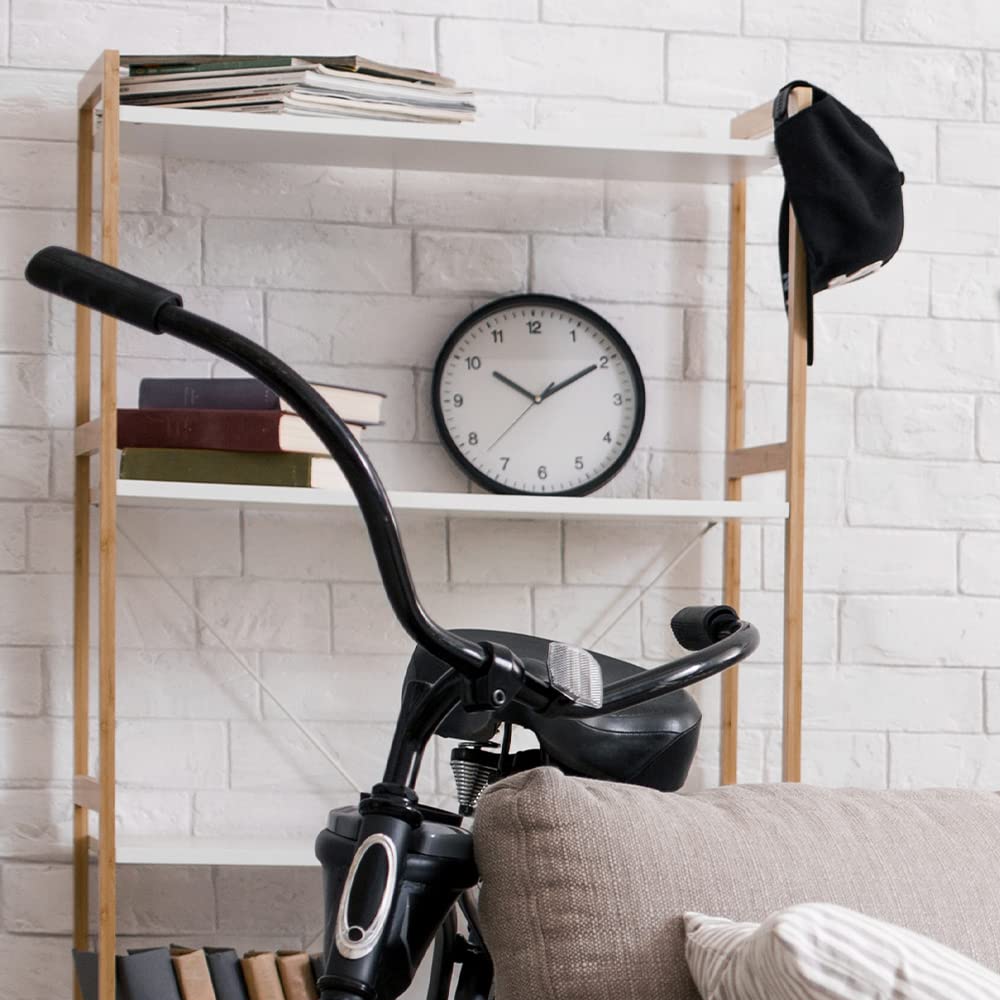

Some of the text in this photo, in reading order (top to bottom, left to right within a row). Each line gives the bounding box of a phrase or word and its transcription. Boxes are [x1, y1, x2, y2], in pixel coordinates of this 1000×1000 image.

[526, 320, 542, 334] 12
[491, 330, 504, 343] 11
[569, 330, 577, 343] 1
[465, 356, 481, 370] 10
[599, 356, 609, 369] 2
[453, 394, 464, 408] 9
[613, 393, 623, 406] 3
[468, 432, 478, 446] 8
[602, 431, 612, 444] 4
[500, 457, 510, 471] 7
[574, 456, 584, 470] 5
[537, 466, 548, 480] 6
